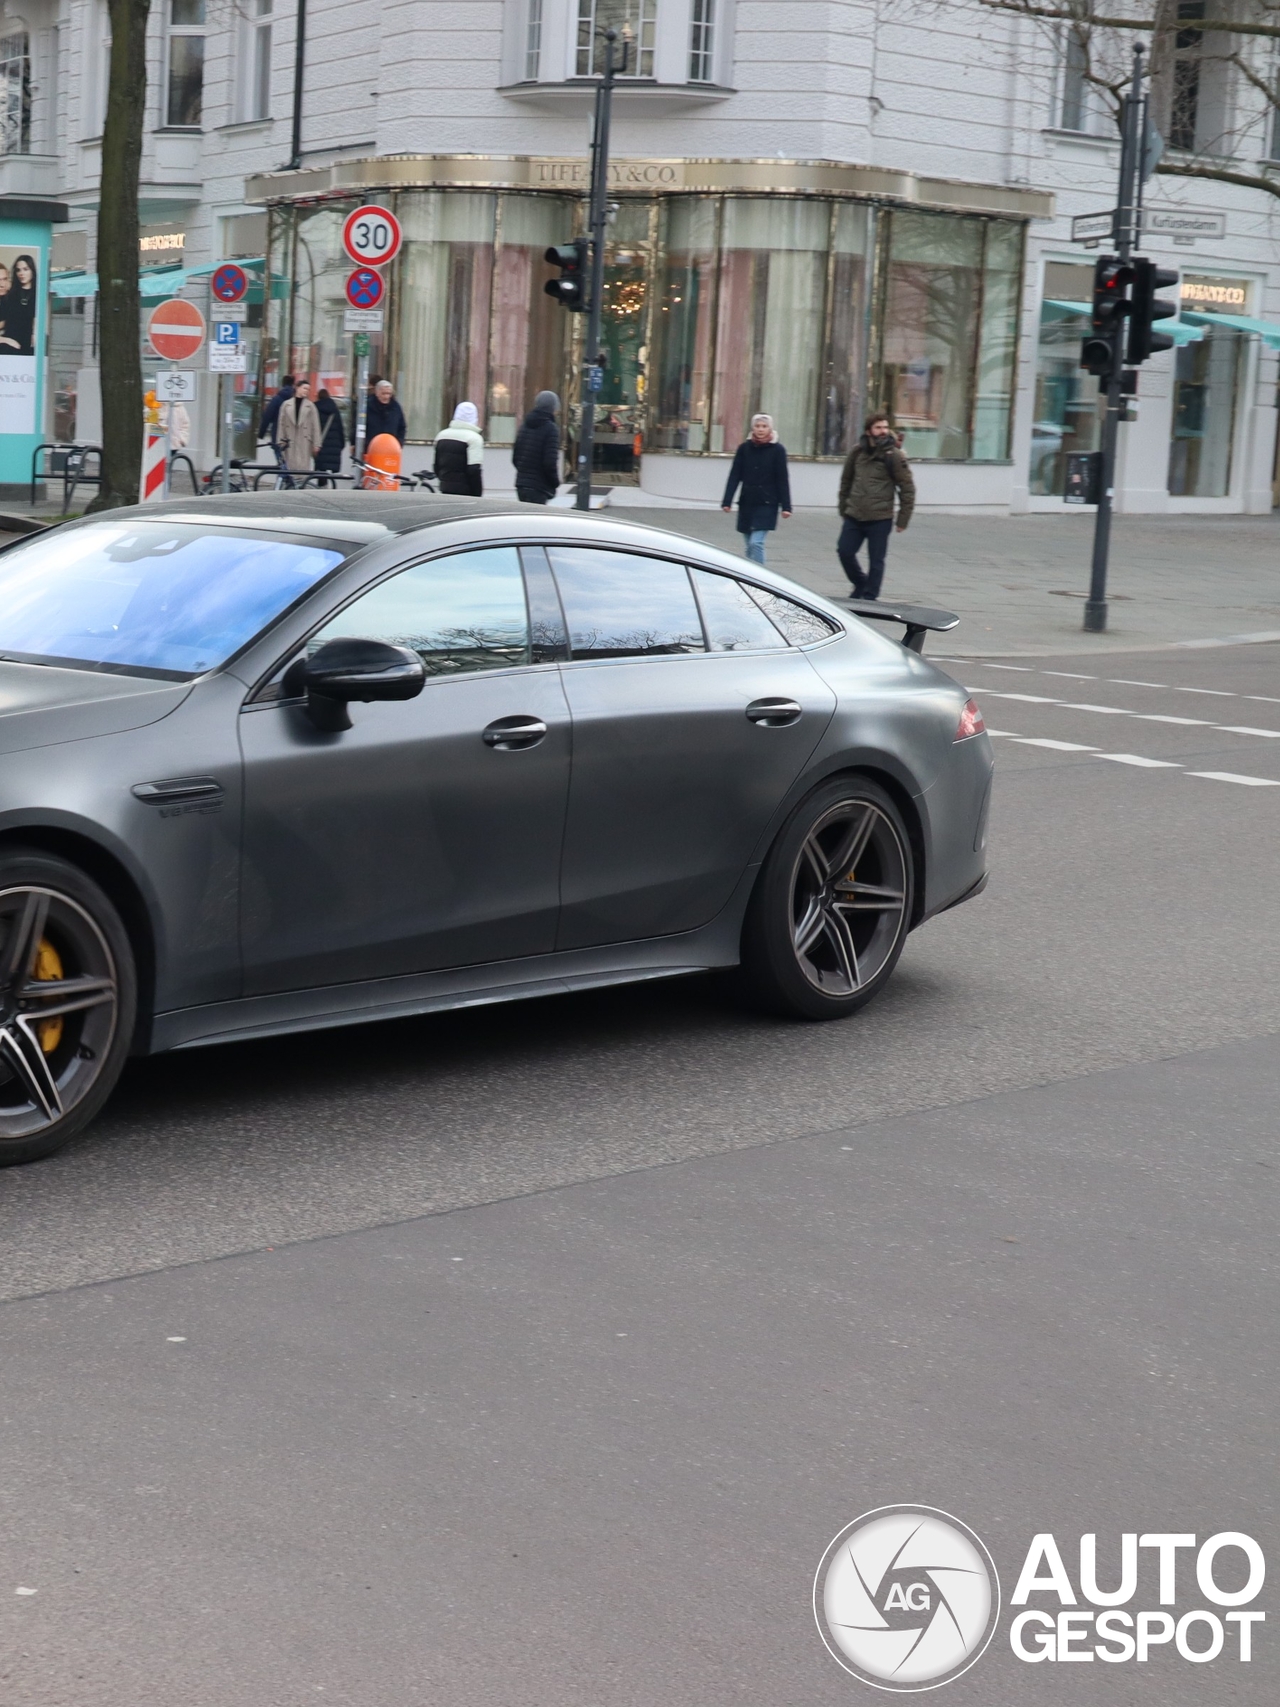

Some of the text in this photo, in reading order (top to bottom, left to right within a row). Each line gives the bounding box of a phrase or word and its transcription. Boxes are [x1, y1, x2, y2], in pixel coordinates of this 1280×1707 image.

[536, 163, 677, 183] TIFFY&CO.
[355, 222, 388, 250] 30
[219, 323, 234, 343] P
